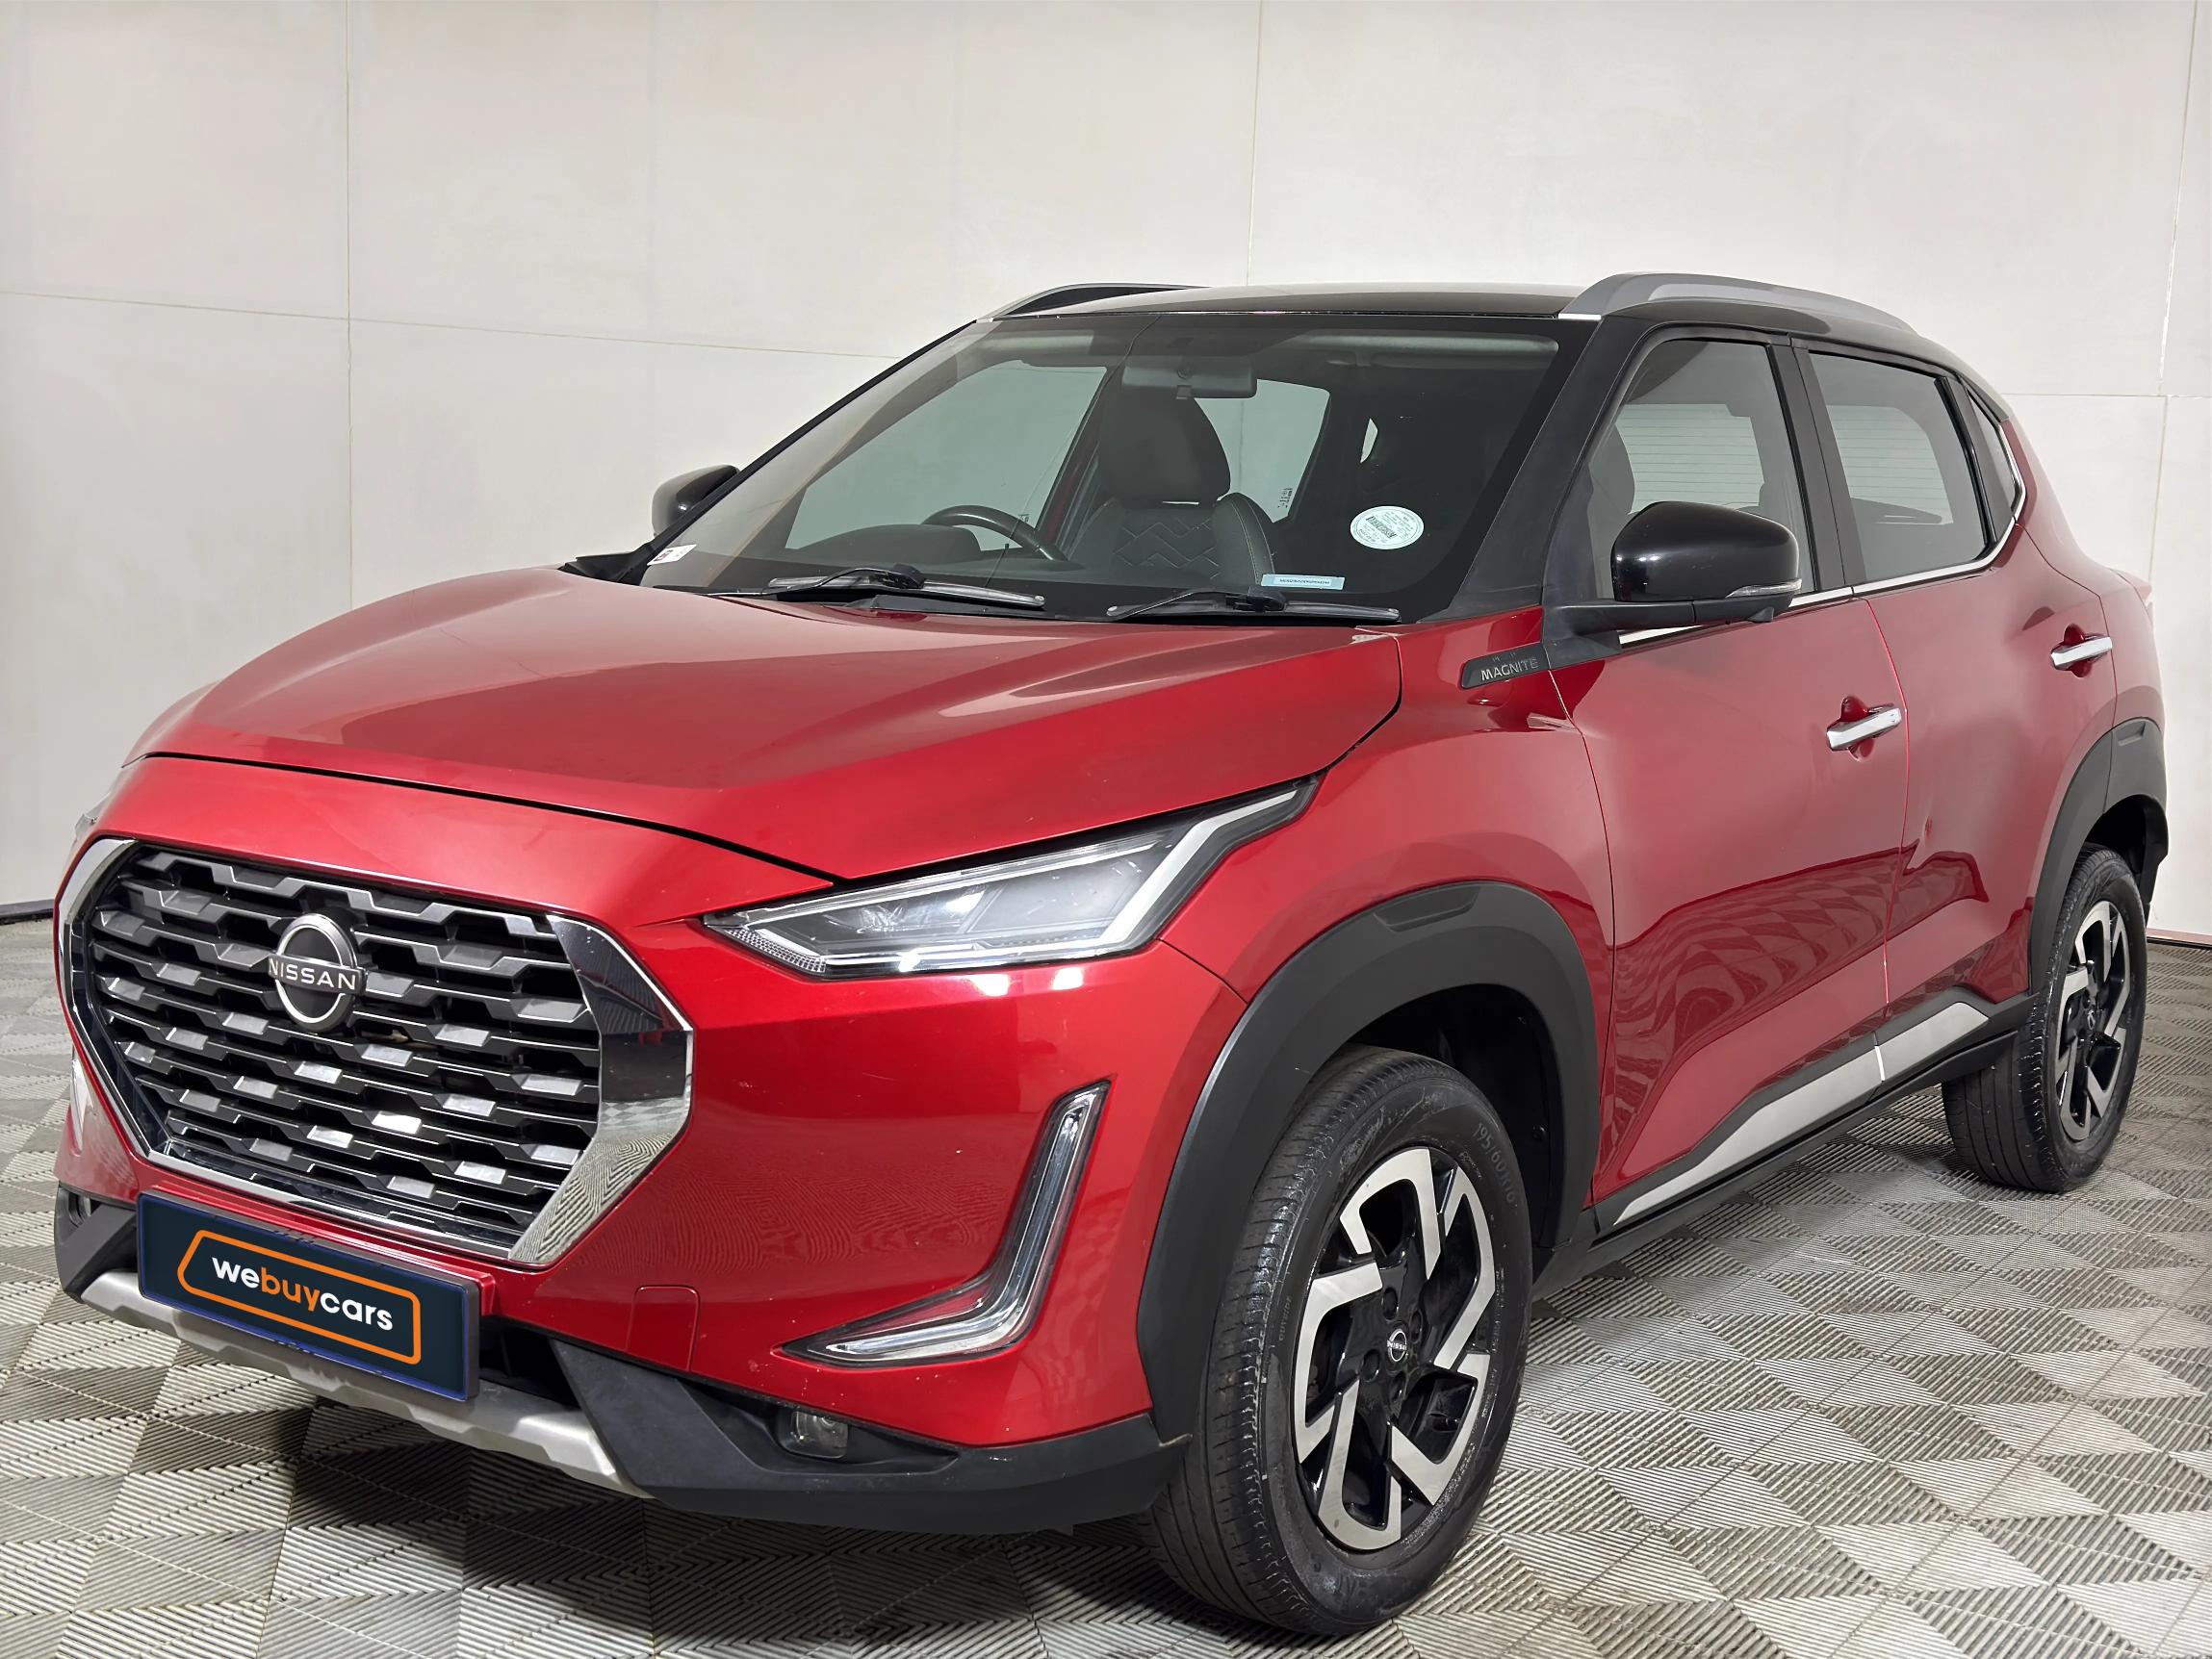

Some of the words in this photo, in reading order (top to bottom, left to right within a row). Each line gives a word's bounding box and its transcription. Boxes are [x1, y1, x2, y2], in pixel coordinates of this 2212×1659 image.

[1480, 658, 1539, 681] MAGNITE
[269, 957, 356, 990] NISSAN
[211, 1256, 394, 1332] webuycars
